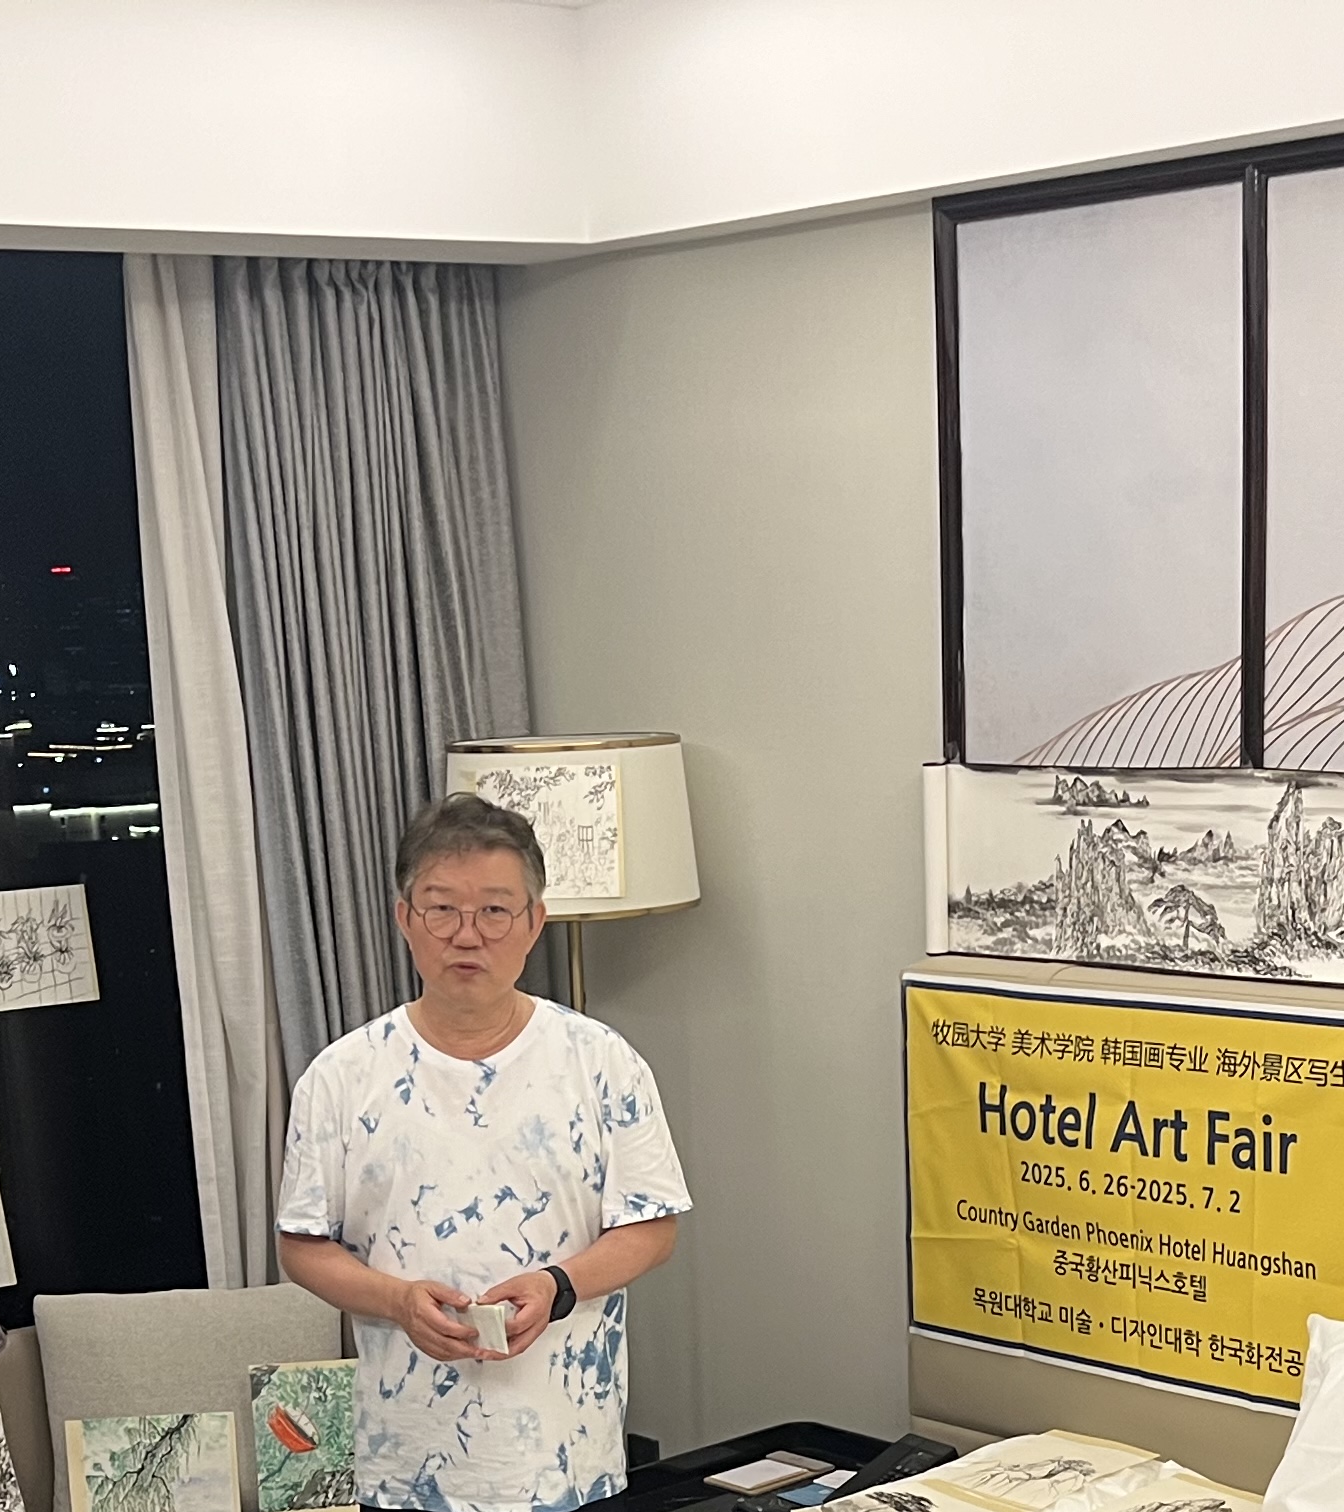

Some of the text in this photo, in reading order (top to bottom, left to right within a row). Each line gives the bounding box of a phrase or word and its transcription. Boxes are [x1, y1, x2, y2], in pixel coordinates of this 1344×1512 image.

[930, 1018, 1006, 1054] 牧园大学
[1011, 1028, 1095, 1064] 美术学院
[1099, 1036, 1209, 1075] 韩国画专业
[978, 1081, 1298, 1175] Hotel Art Fair
[1020, 1160, 1072, 1192] 2025.
[1229, 1190, 1241, 1214] 2
[956, 1199, 1318, 1280] Country Garden Phoenix Hotel Huangshan
[1053, 1249, 1208, 1303] 중국황산피닉스호텔
[972, 1286, 1054, 1324] 목원대학교
[1058, 1305, 1092, 1336] 미술
[1111, 1316, 1202, 1358] 디자인대학
[1207, 1333, 1304, 1378] 한국화전공
